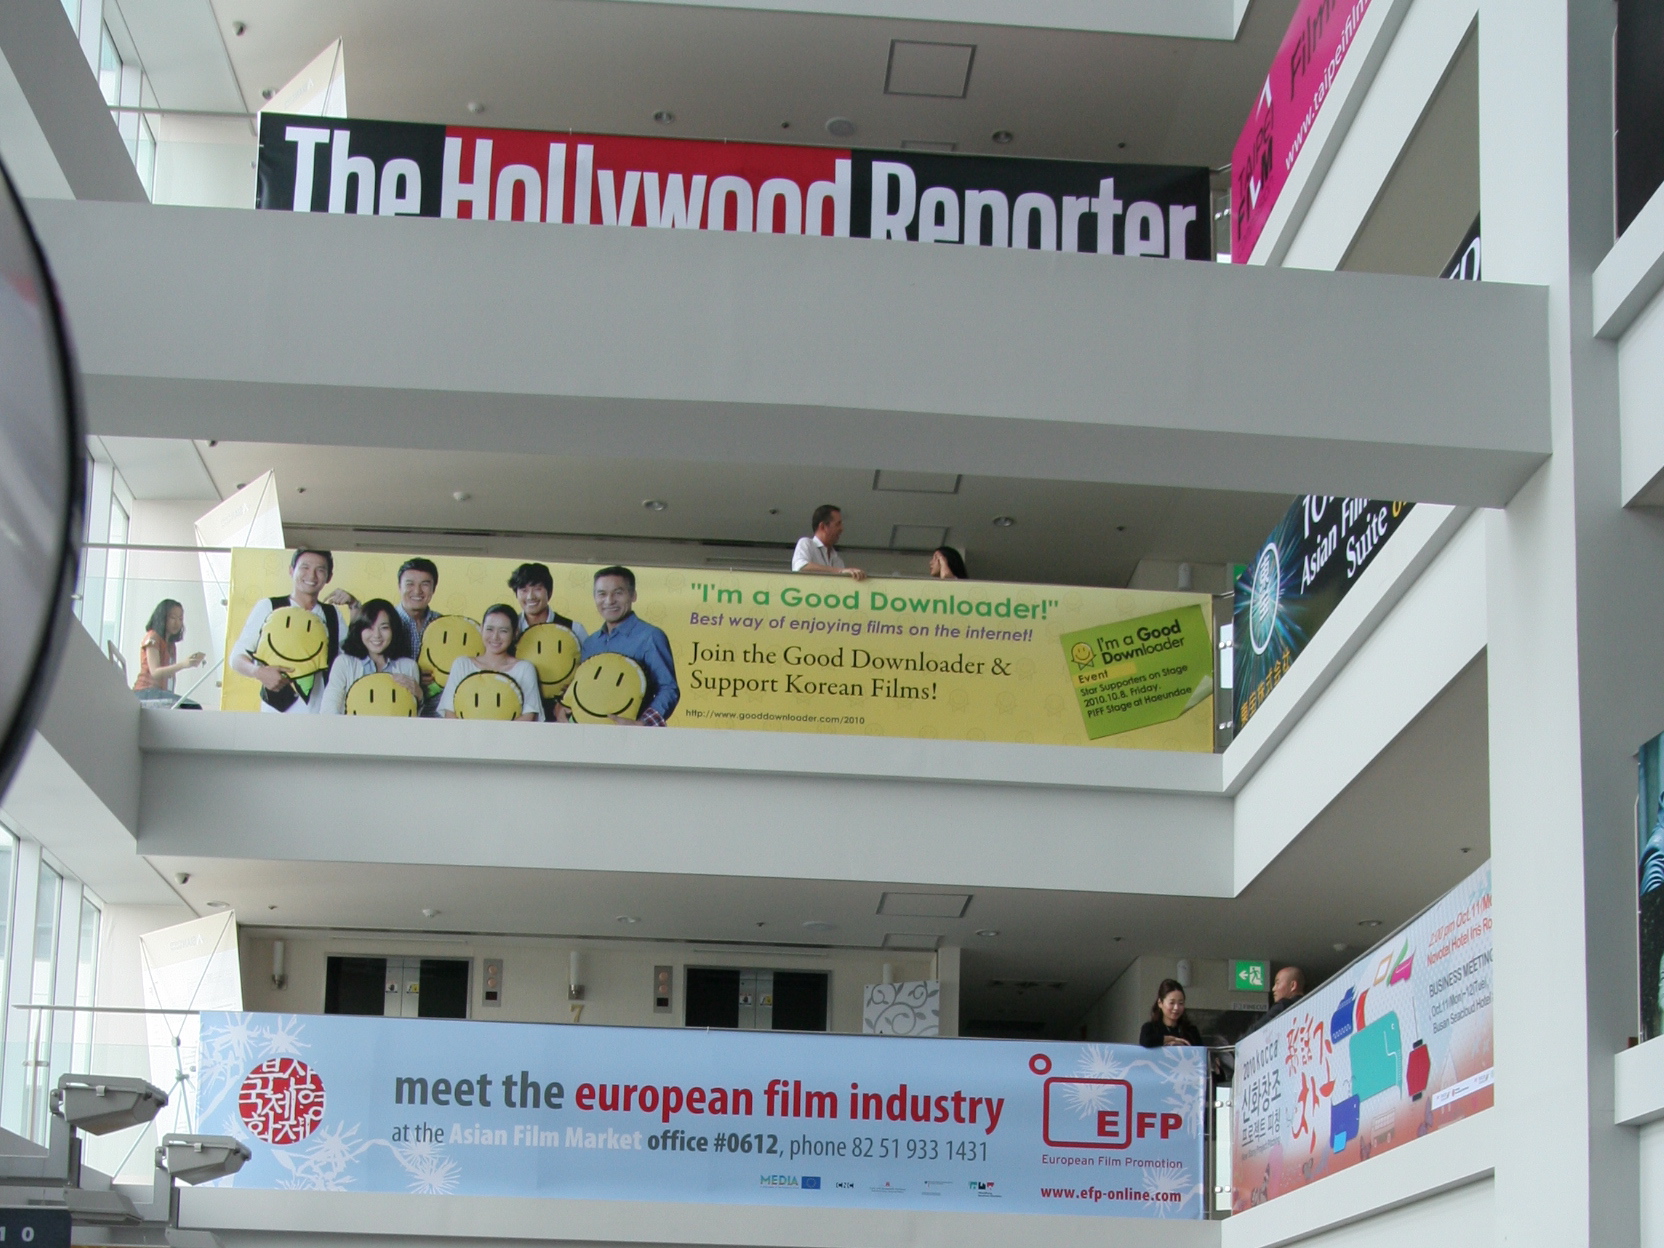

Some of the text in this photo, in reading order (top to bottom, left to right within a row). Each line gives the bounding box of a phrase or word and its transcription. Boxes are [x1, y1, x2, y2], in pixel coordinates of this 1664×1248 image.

[285, 125, 422, 215] The
[441, 135, 852, 236] Hollywood
[870, 160, 1198, 260] Reporter
[1346, 506, 1388, 579] Suite
[1300, 524, 1337, 596] Asian
[752, 590, 770, 606] a
[780, 587, 860, 611] Good
[870, 590, 1059, 620] Downloader!"
[689, 612, 1033, 642] Best way of enjoying films on the internet!
[1097, 619, 1182, 652] I'm a Good
[688, 641, 1012, 676] Join the Good Downloader &
[1101, 636, 1186, 665] Downloader
[690, 669, 937, 700] Support Korean Films!
[1078, 669, 1109, 684] Event
[1080, 664, 1188, 697] Star Supporters on Stage
[685, 709, 866, 725] http://www.gooddownloader.com/2010
[1087, 685, 1193, 719] PIFF Stage at Haeundae
[1451, 929, 1469, 952] Hotel
[1428, 967, 1463, 998] BUSINESS
[570, 1003, 585, 1023] 7
[1432, 1018, 1450, 1034] Busan
[395, 1070, 1005, 1136] meet the european film industry
[1242, 1068, 1282, 1124] 신화창조
[392, 1121, 988, 1162] at the Asian Film Market office #0612, phone 82 51 933 1431
[1042, 1154, 1183, 1169] European Film Promotion
[760, 1174, 799, 1186] MEDIA
[1040, 1186, 1182, 1203] www.efp-online.com
